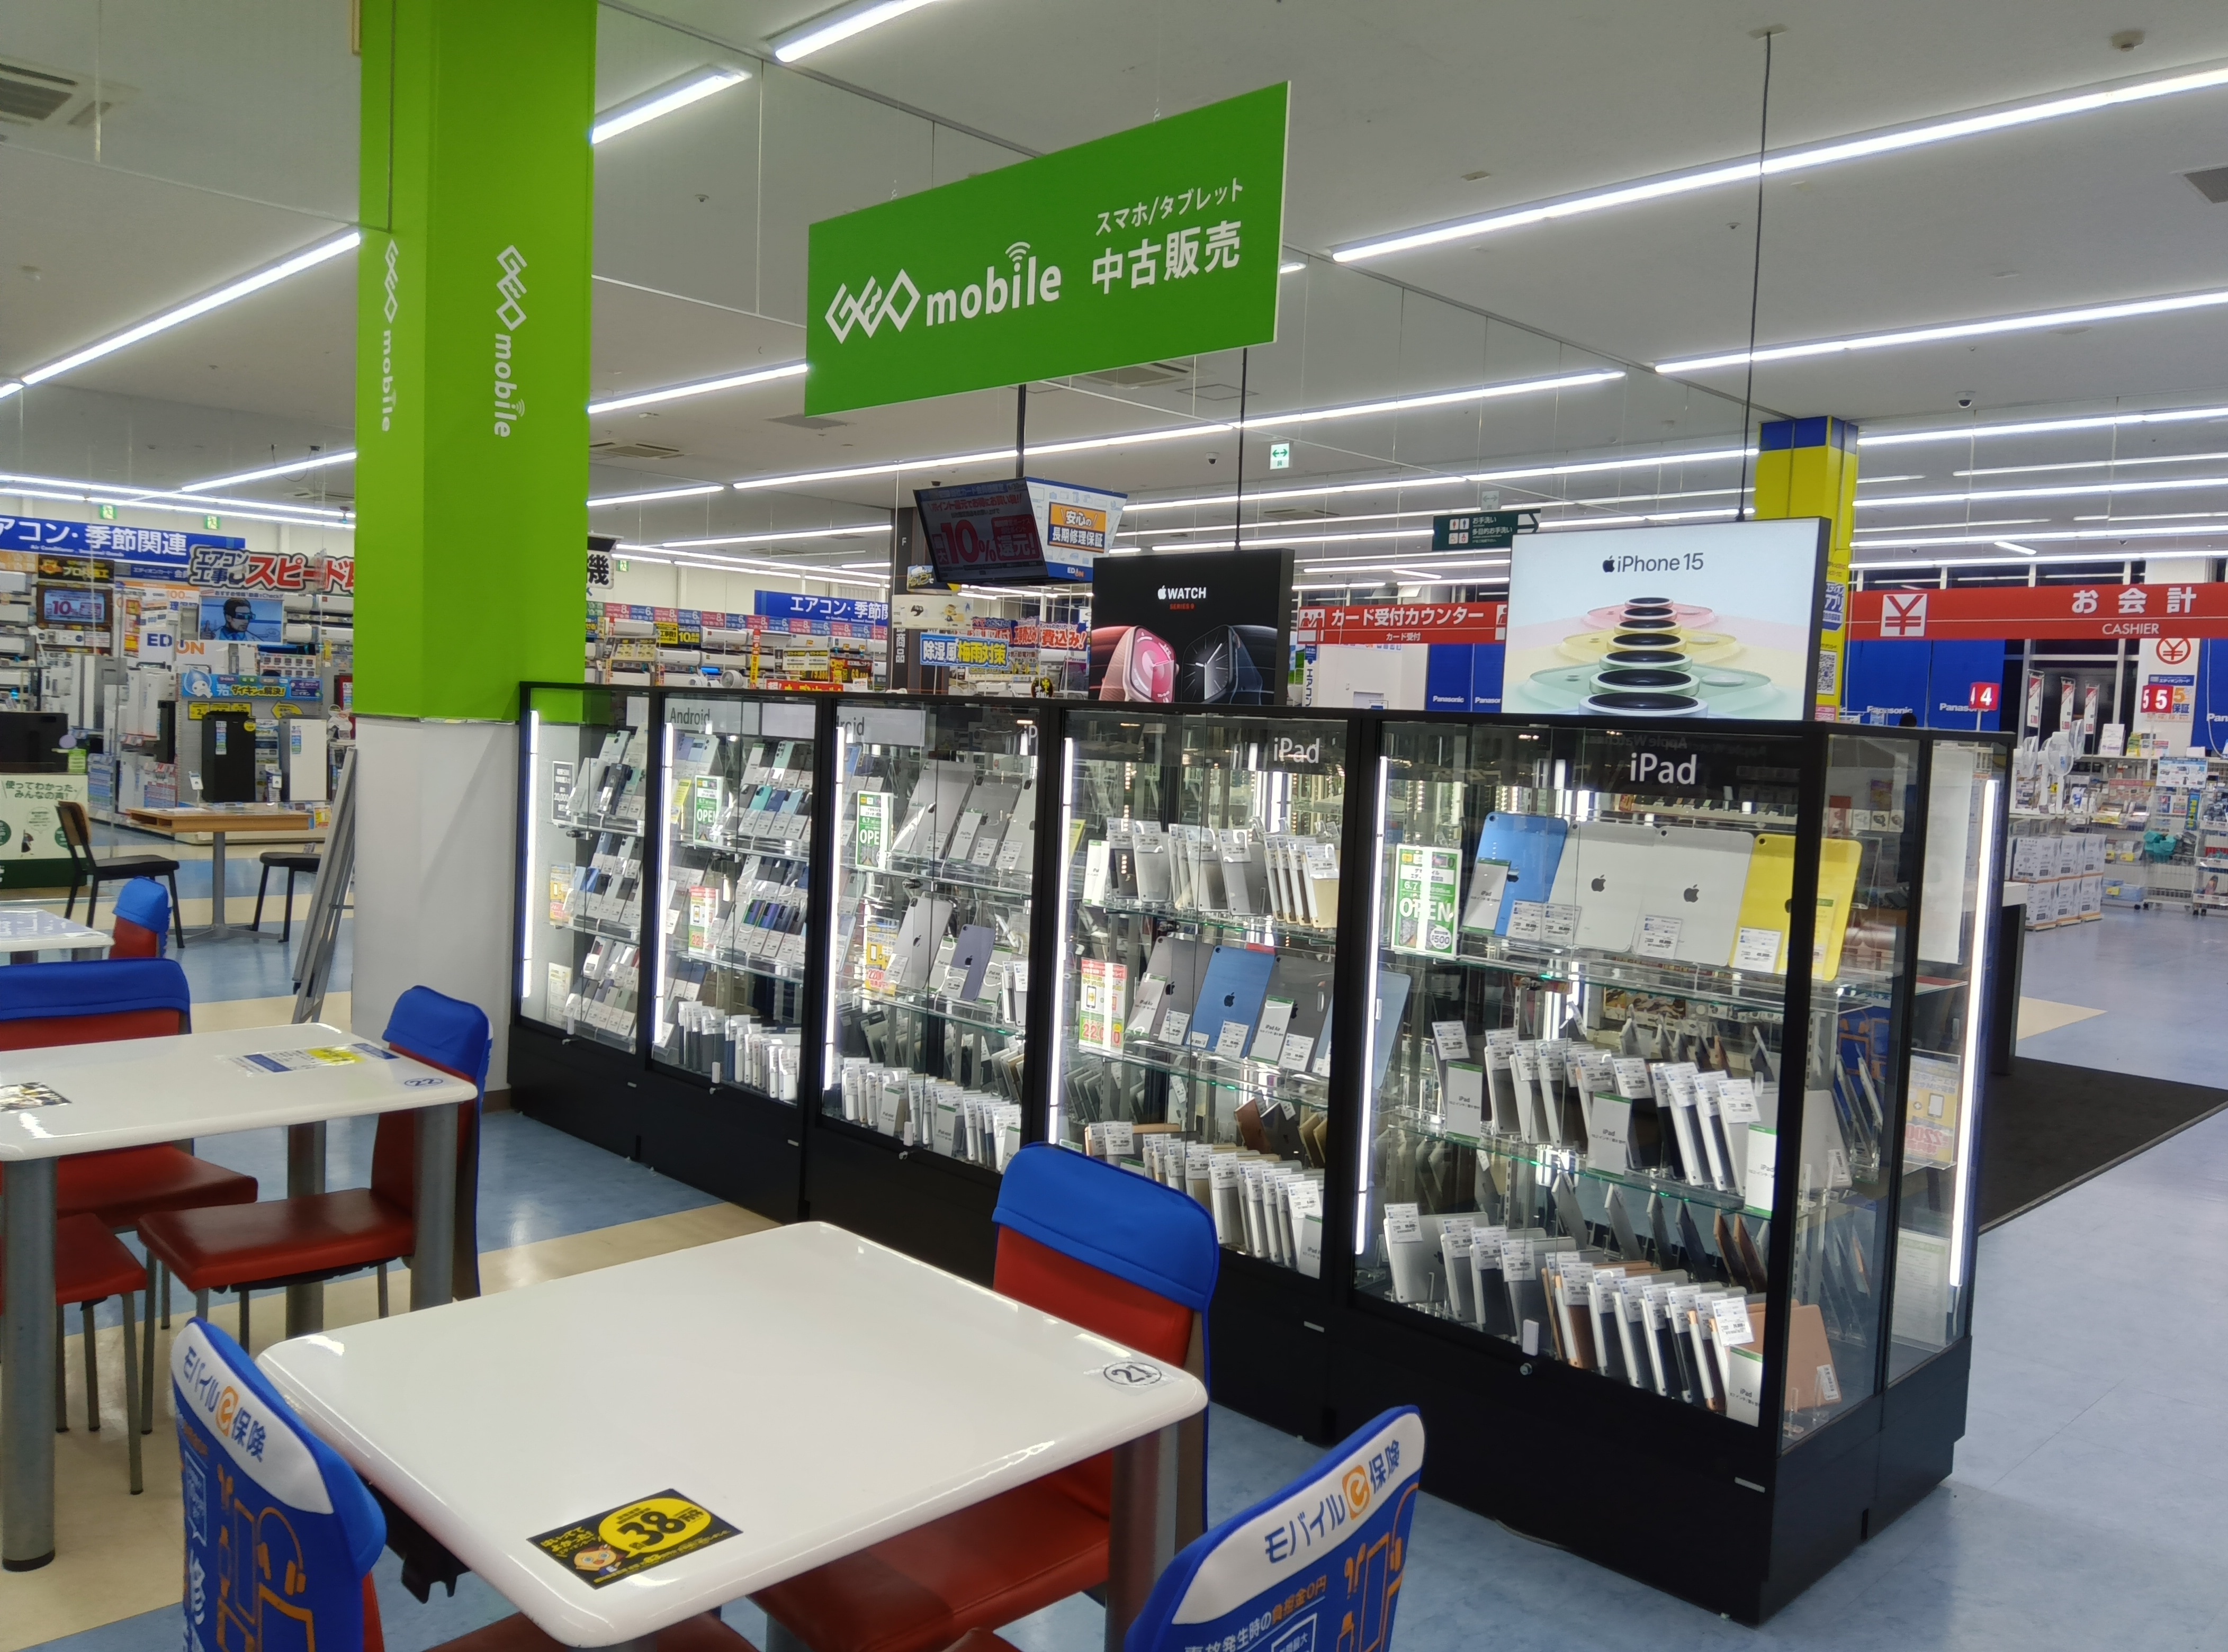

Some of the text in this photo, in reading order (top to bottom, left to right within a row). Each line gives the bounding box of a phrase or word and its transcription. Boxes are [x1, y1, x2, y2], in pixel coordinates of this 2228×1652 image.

[1095, 177, 1243, 237] スマホ/タブレット
[1091, 220, 1241, 294] 中古販売
[825, 256, 1061, 344] GEO mobile
[382, 329, 393, 432] mobile
[493, 333, 518, 437] mobile
[1066, 509, 1092, 527] 安心の
[941, 519, 997, 564] 10%
[1052, 526, 1103, 547] 長期修理保証
[1616, 552, 1704, 573] iPhone 15
[1167, 587, 1206, 600] WATCH
[2071, 587, 2197, 615] お会計
[1331, 605, 1484, 627] カード受付カウンター
[1386, 632, 1421, 642] カード受付
[2102, 623, 2160, 635] CASHIER
[1980, 687, 1993, 706] 4
[2155, 689, 2168, 710] 5
[670, 707, 710, 726] Android
[1274, 737, 1320, 764] iPad
[1630, 752, 1697, 785] iPad
[1740, 1388, 1753, 1398] iPad
[616, 1511, 686, 1546] 38
